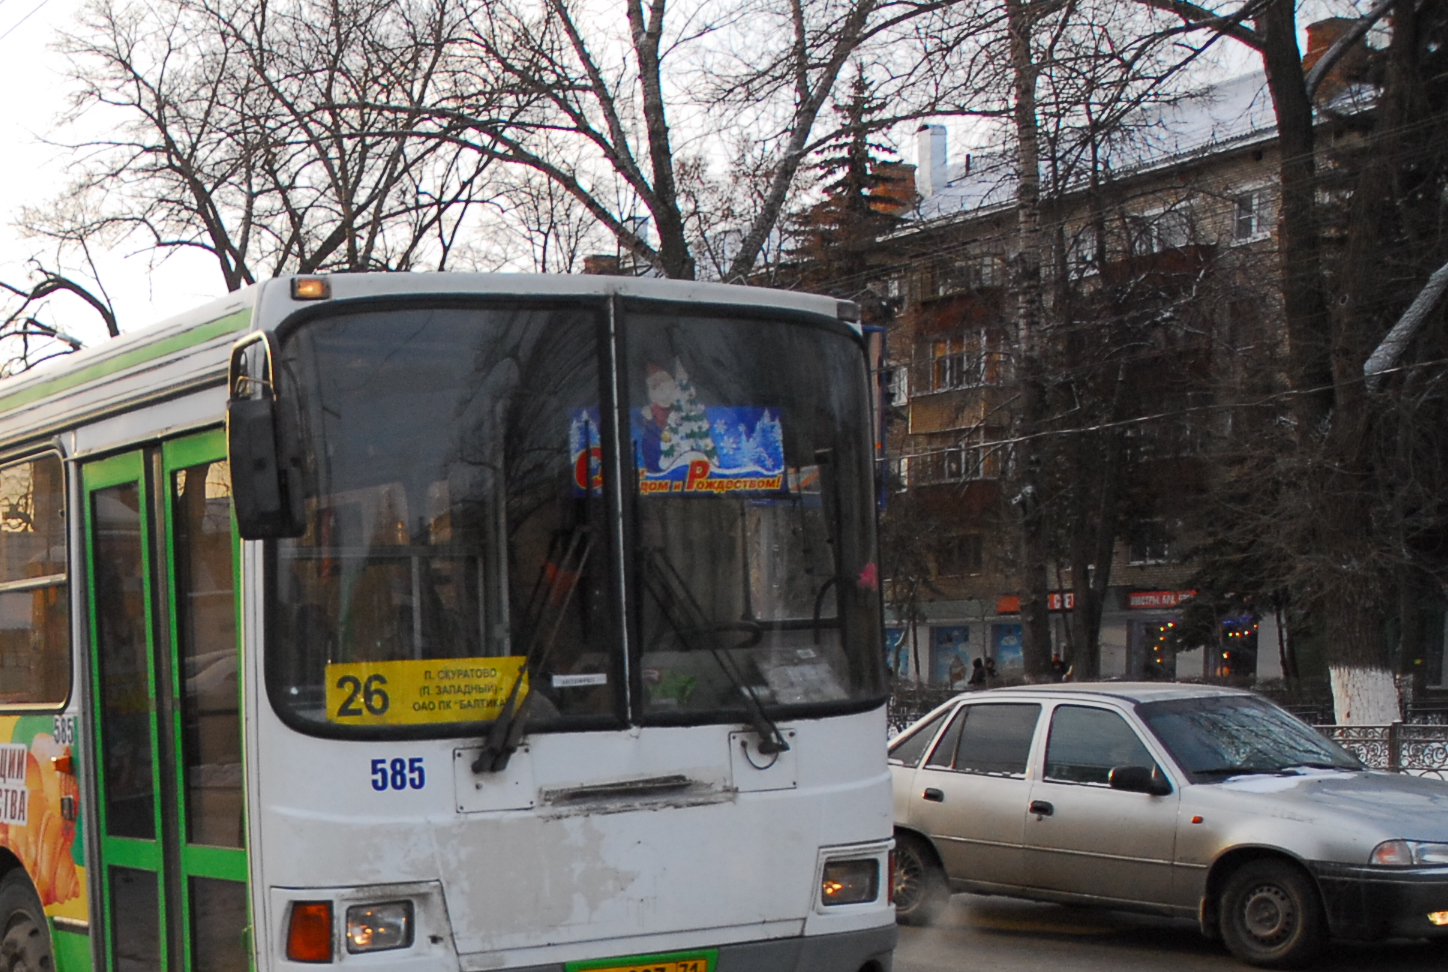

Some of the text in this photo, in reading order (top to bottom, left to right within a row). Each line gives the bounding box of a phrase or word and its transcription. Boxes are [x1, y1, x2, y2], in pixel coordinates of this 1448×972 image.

[685, 459, 782, 493] Рождеством!
[335, 674, 390, 718] 26
[437, 668, 498, 681] СКУРАТОВО
[435, 683, 498, 697] ЗАПАДНЫЙ)
[412, 701, 436, 712] ОАО
[439, 701, 452, 711] ПК
[54, 718, 74, 745] 585
[370, 757, 426, 791] 585
